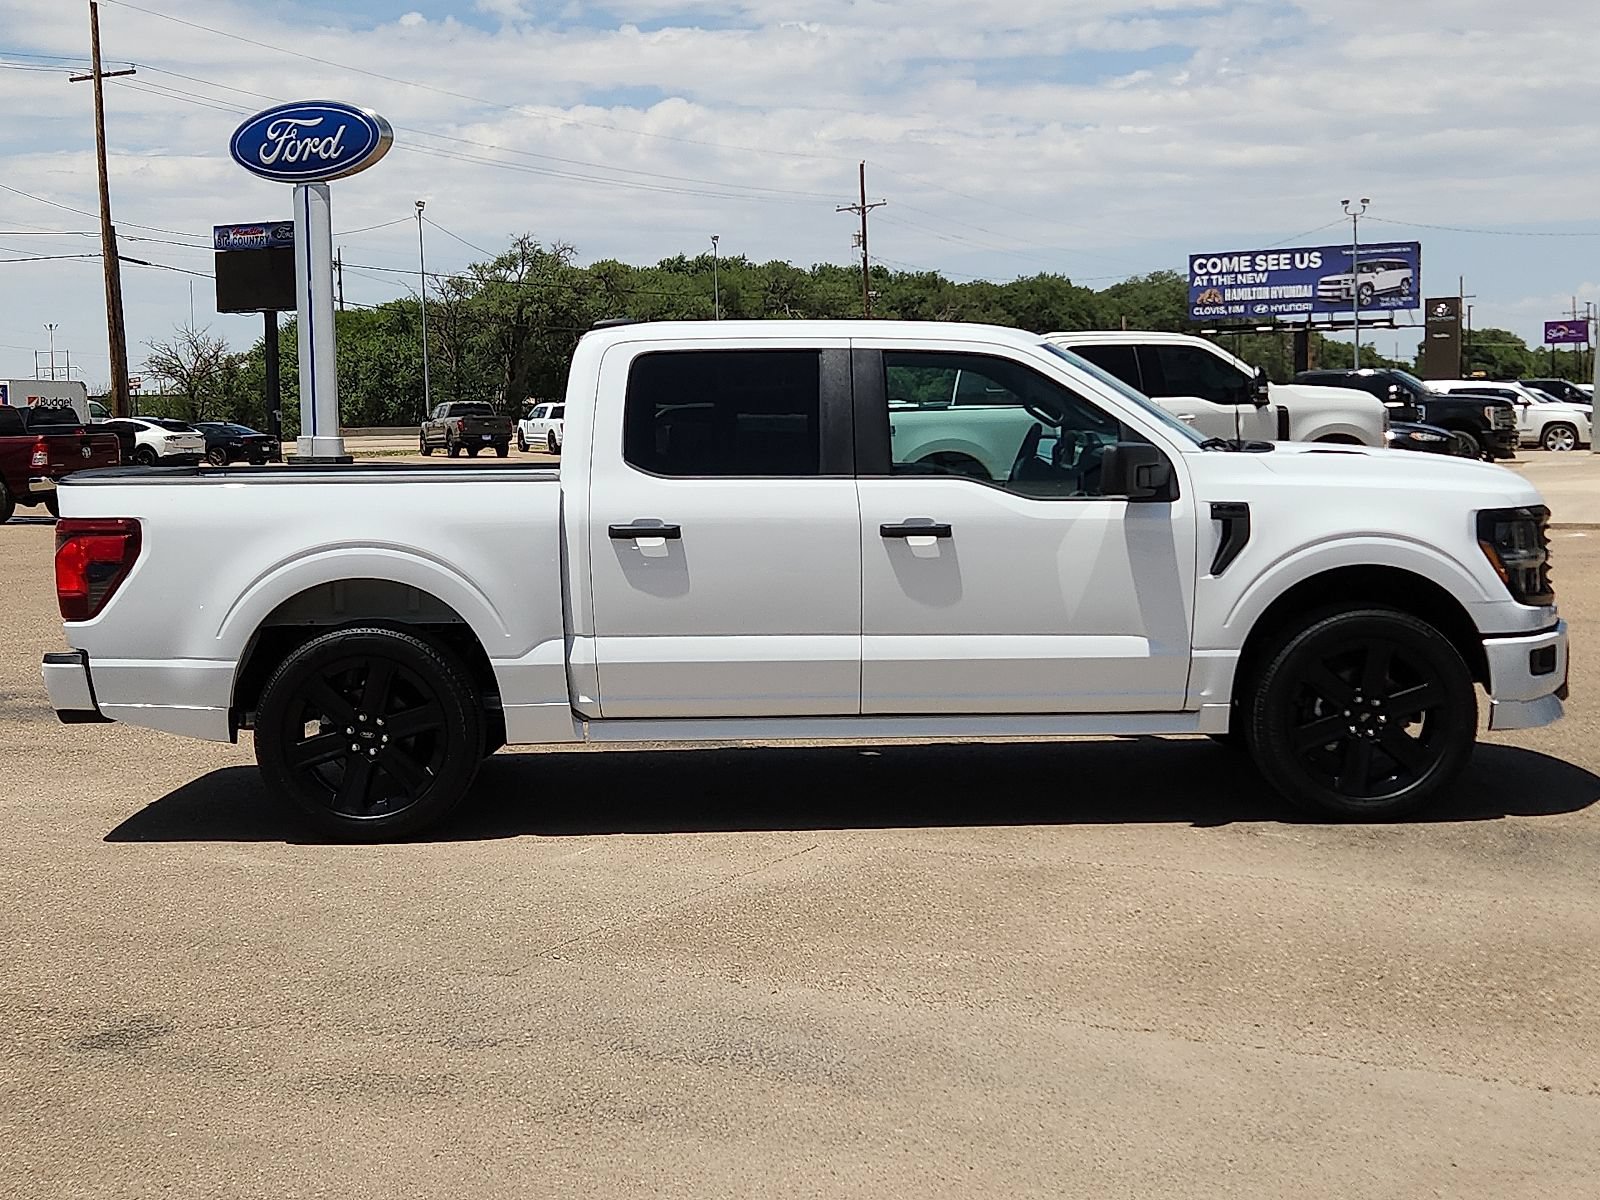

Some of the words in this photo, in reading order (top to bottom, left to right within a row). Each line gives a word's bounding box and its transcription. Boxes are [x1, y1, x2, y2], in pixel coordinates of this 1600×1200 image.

[259, 117, 346, 165] Ford
[232, 235, 270, 246] COUNTRY
[1193, 256, 1251, 274] COME
[1254, 253, 1291, 271] SEE
[1294, 251, 1323, 270] US
[1193, 275, 1209, 287] AT
[1210, 274, 1236, 286] THE
[1237, 272, 1268, 284] NEW
[1224, 287, 1270, 301] HAMILTON
[1270, 284, 1313, 299] HYUNDAI
[1193, 305, 1227, 316] CLOVIS,
[1228, 304, 1245, 314] NM
[1270, 302, 1313, 312] HYUNDAI
[40, 397, 73, 407] Budget
